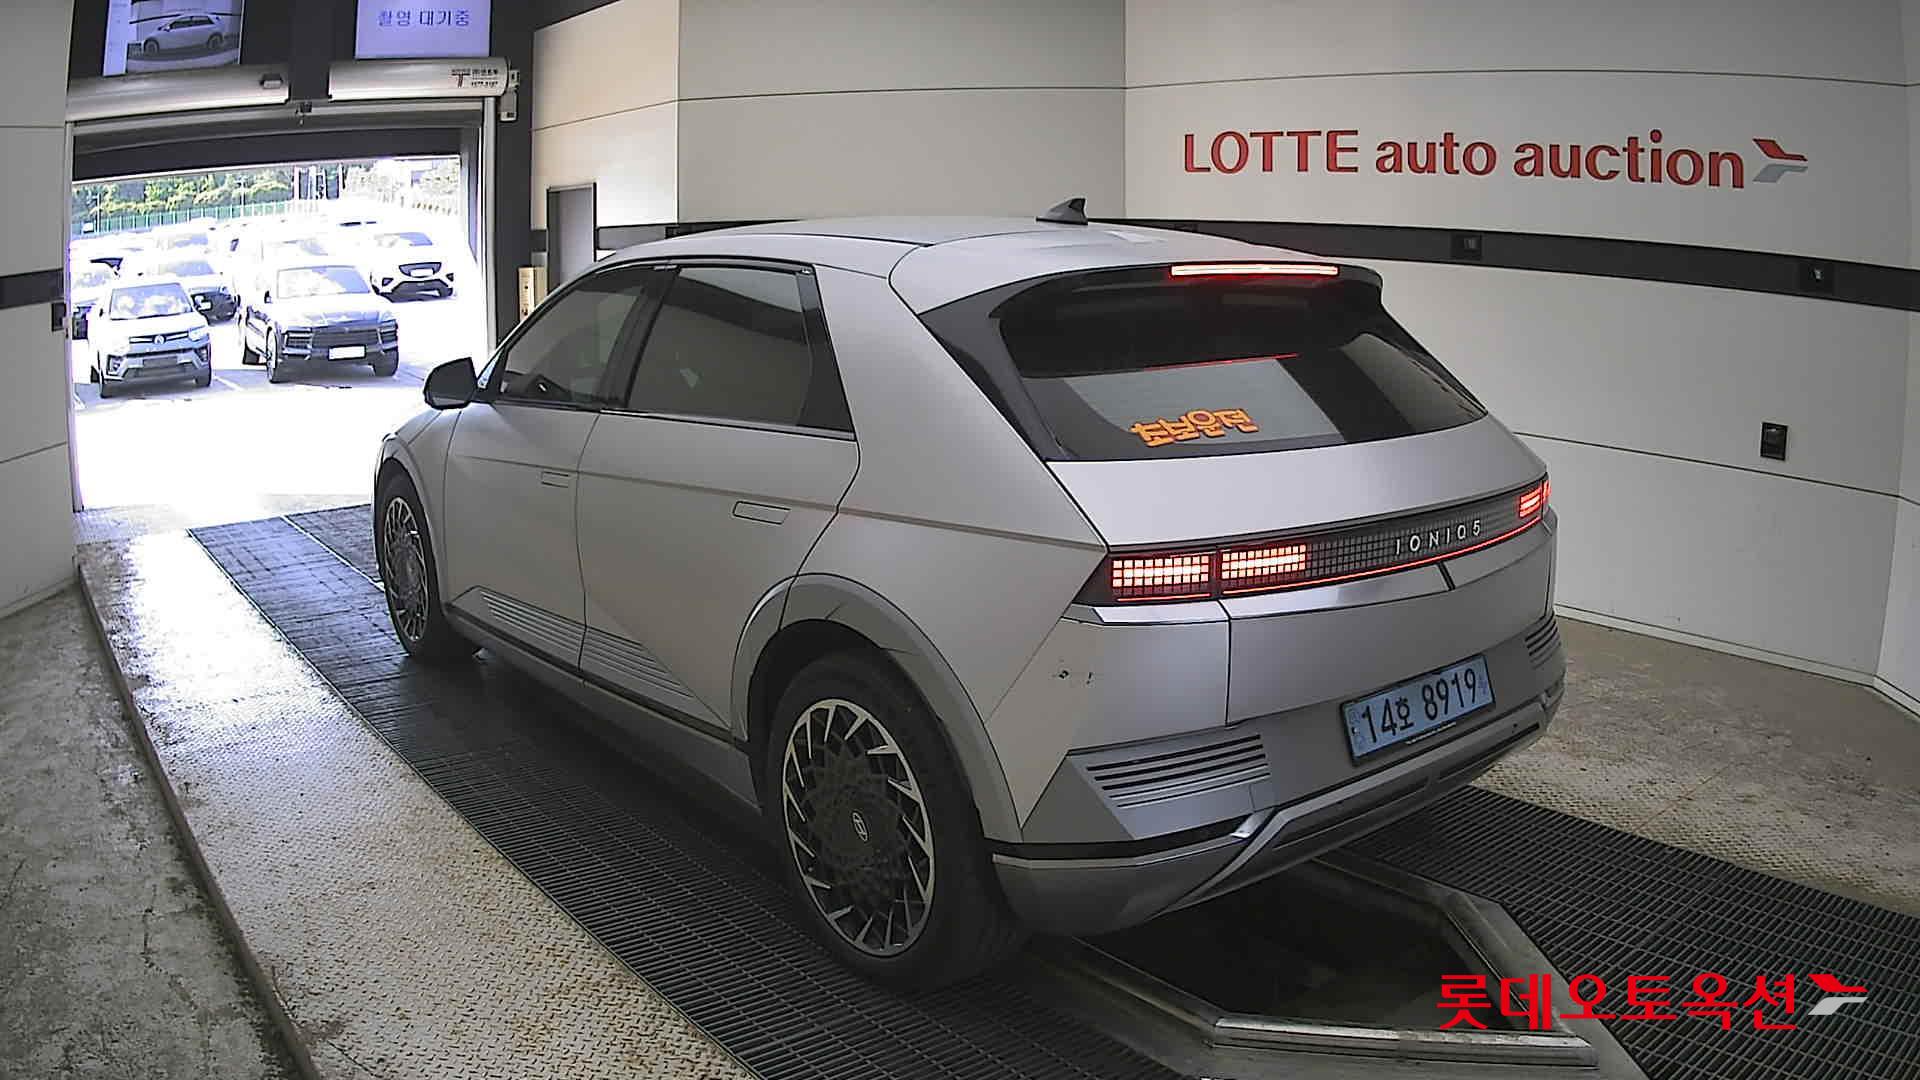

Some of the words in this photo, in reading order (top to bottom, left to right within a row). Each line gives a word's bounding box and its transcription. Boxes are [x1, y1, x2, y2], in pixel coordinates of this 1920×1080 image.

[419, 9, 469, 26] 대기중
[1184, 130, 1359, 174] LOTTE
[1375, 132, 1497, 176] auto
[1513, 129, 1745, 189] auction
[1361, 697, 1415, 743] 14호
[1421, 667, 1477, 721] 8919
